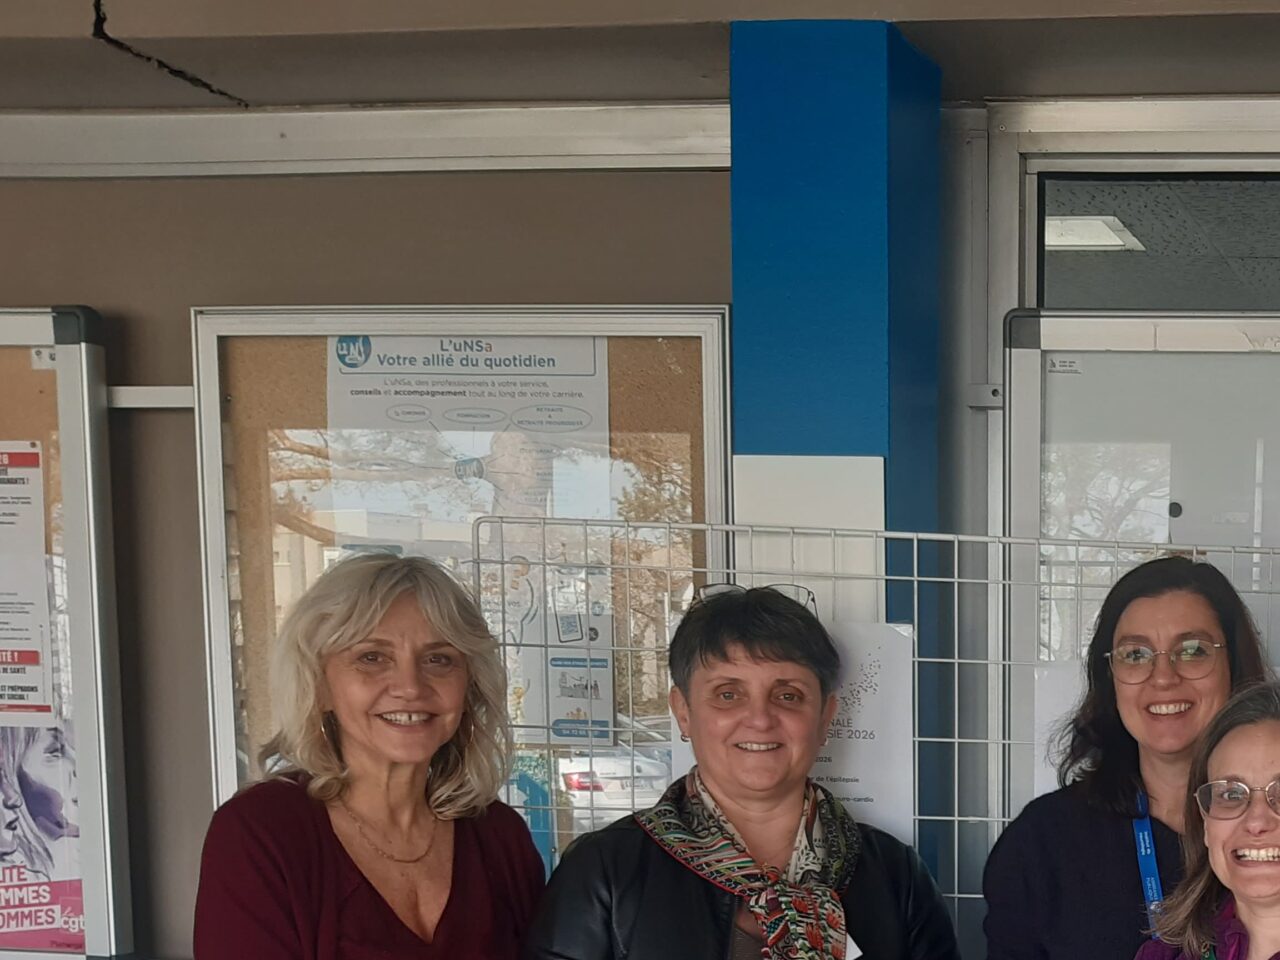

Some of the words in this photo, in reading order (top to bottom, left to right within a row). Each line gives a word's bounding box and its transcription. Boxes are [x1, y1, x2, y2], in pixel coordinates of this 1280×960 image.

[376, 353, 417, 366] Votre
[422, 352, 455, 367] allié
[459, 354, 479, 367] du
[484, 354, 556, 370] quotidien
[350, 388, 382, 396] conseils
[393, 389, 467, 398] accompagnement
[530, 391, 550, 399] votre
[847, 729, 876, 740] 2026
[61, 913, 86, 933] cgt
